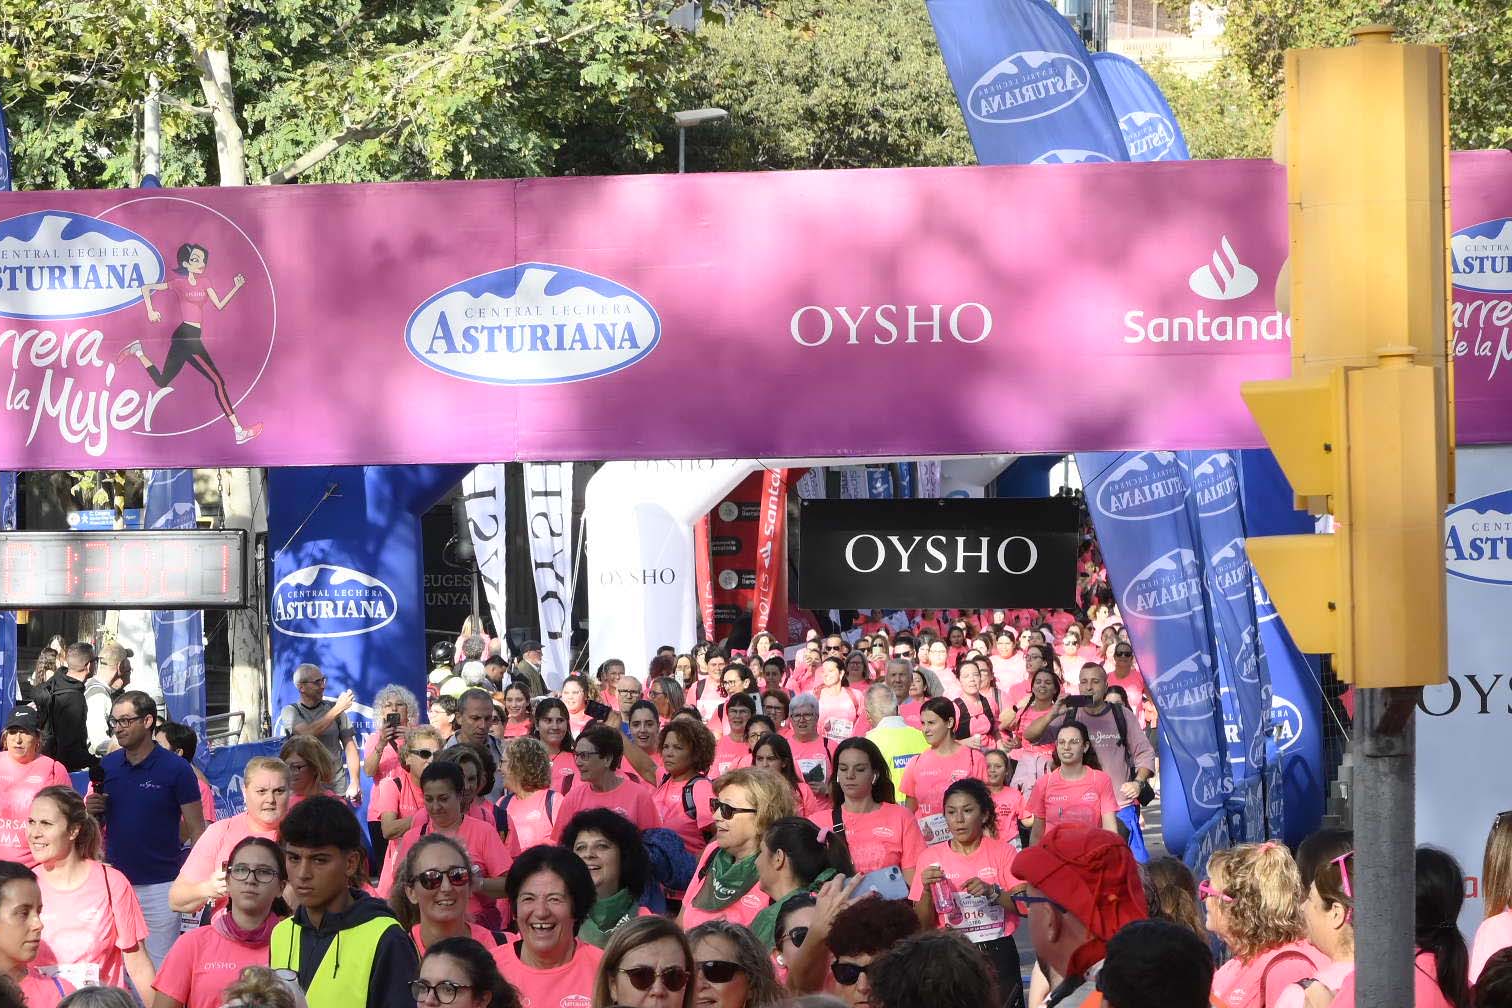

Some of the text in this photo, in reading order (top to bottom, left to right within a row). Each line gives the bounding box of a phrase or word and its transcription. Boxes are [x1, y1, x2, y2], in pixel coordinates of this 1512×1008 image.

[67, 245, 140, 258] LECHERA
[463, 303, 633, 319] CENTRAL LECHERA
[790, 302, 994, 347] OYSHO
[425, 309, 641, 356] ASTURIANA
[1474, 329, 1493, 356] la
[6, 371, 31, 412] la
[25, 366, 175, 457] Mujer
[844, 533, 1039, 576] OYSHO
[600, 567, 676, 585] OYSHO
[287, 588, 384, 600] CENTRAL LECHERA
[274, 594, 388, 623] ASTURIANA
